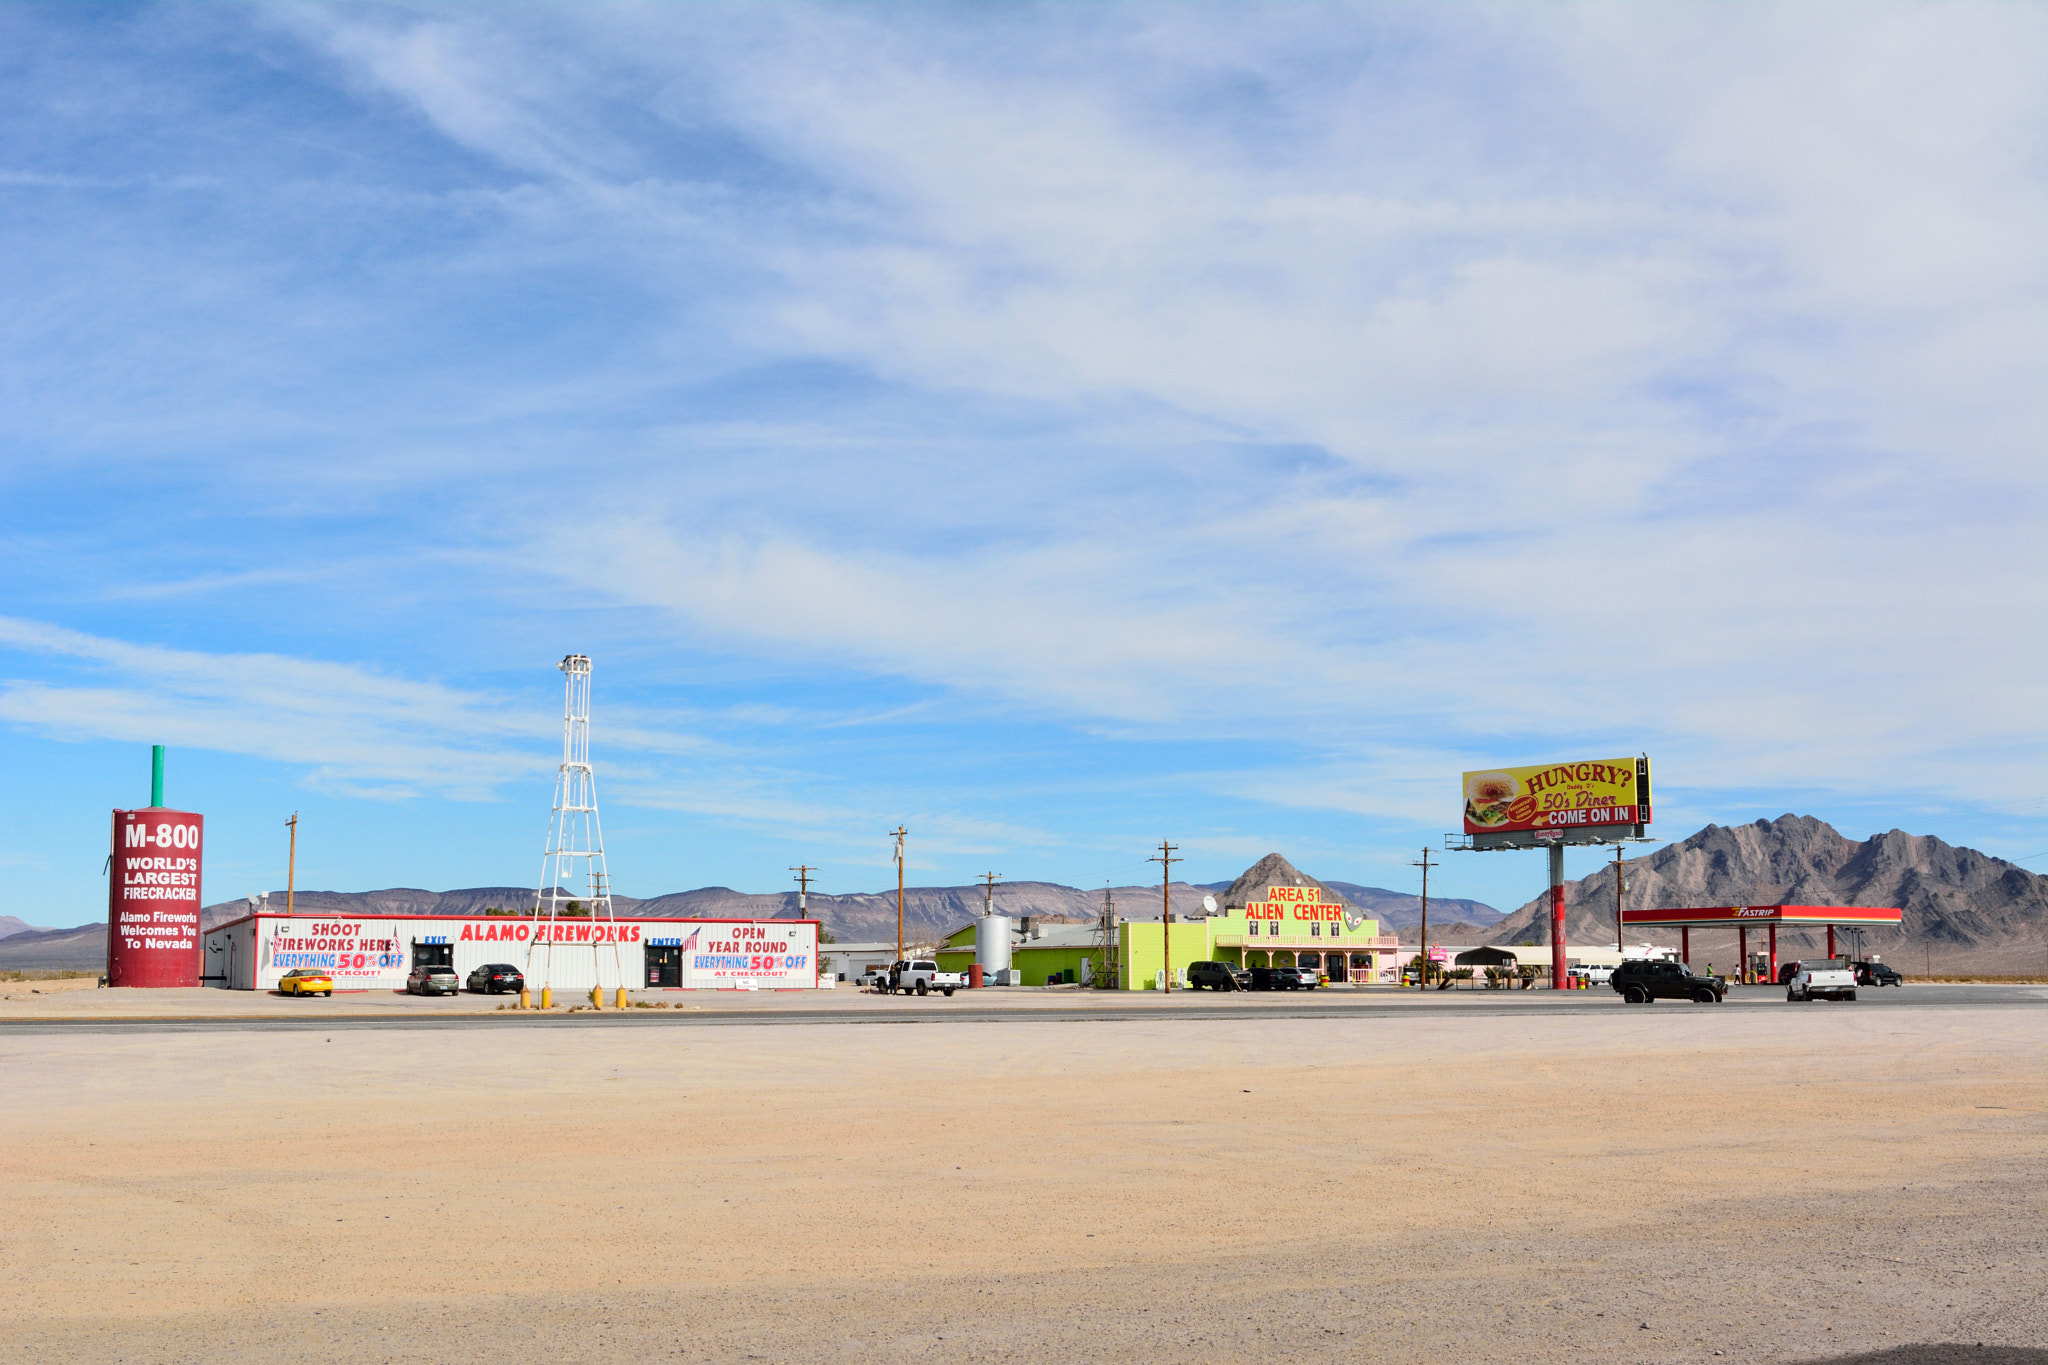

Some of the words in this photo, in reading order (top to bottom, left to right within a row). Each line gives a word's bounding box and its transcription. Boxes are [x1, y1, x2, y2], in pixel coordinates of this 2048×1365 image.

[1525, 763, 1632, 795] HUNGRY?
[1543, 791, 1570, 810] 50's
[1575, 790, 1617, 807] Diner
[1549, 809, 1587, 825] COME
[1590, 807, 1610, 822] ON
[1614, 806, 1629, 821] IN
[125, 823, 199, 850] M-800
[126, 857, 197, 871] WORLD'S
[124, 872, 197, 886] LARGEST
[123, 887, 197, 901] FIRECRACKER
[1268, 887, 1305, 902] AREA
[1307, 888, 1320, 903] 51
[120, 911, 151, 923] Alamo
[153, 911, 197, 923] Fireworks
[1245, 903, 1284, 920] ALIEN
[1293, 903, 1342, 921] CENTER
[1737, 907, 1774, 917] FASTRIP
[120, 925, 179, 936] Welcomes
[181, 925, 197, 936] You
[312, 923, 362, 936] SHOOT
[460, 924, 530, 941] ALAMO
[537, 924, 641, 942] FIREWORKS
[732, 927, 766, 940] OPEN
[125, 938, 141, 949] To
[145, 938, 193, 949] Nevada
[360, 938, 392, 952] HERE
[424, 935, 447, 945] EXIT
[652, 937, 682, 947] ENTER
[708, 941, 740, 953] YEAR
[745, 941, 788, 953] ROUND
[273, 953, 336, 968] EVERYTHING
[378, 954, 404, 968] OFF
[694, 955, 749, 969] EVERYTHING
[785, 956, 807, 969] OFF
